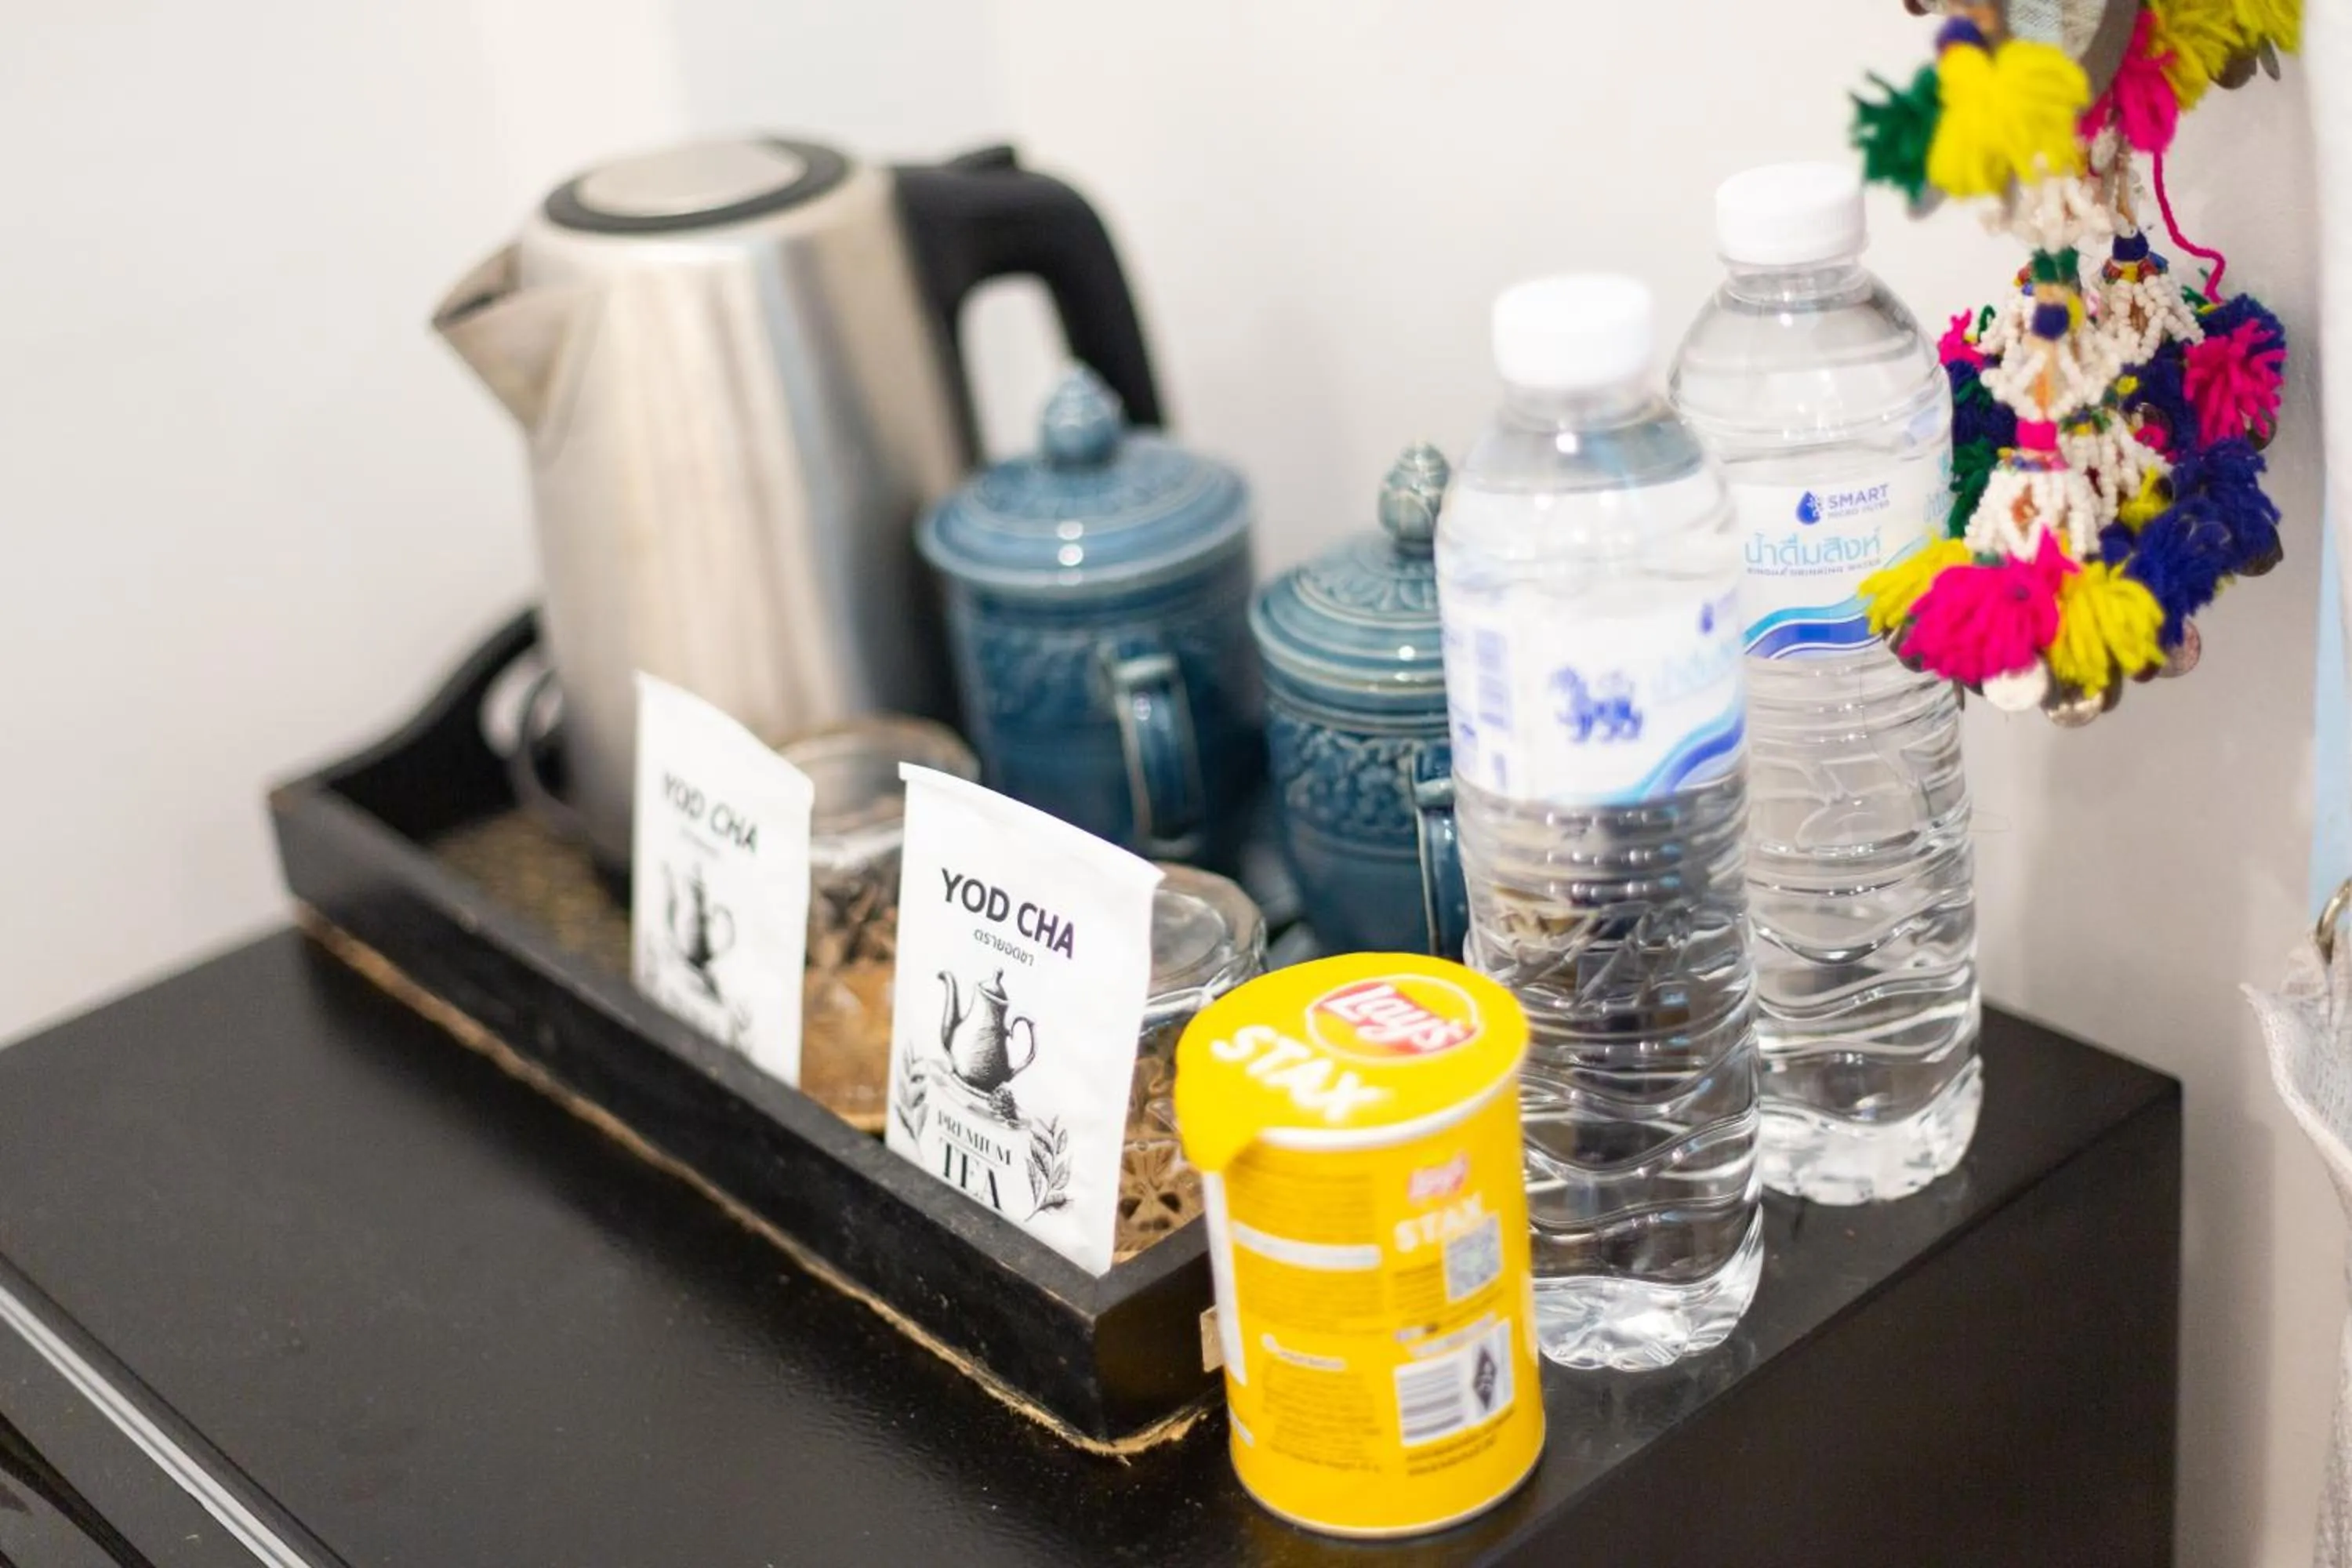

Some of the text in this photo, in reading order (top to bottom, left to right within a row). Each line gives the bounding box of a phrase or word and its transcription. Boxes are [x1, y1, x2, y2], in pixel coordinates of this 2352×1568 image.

[1827, 483, 1889, 510] SMART
[663, 771, 706, 820] YOD
[941, 866, 1074, 960] YOD CHA
[1319, 982, 1469, 1051] Lay's
[1210, 1024, 1393, 1123] STAX
[938, 1109, 1011, 1166] PREMIUM
[940, 1136, 1004, 1211] TEA
